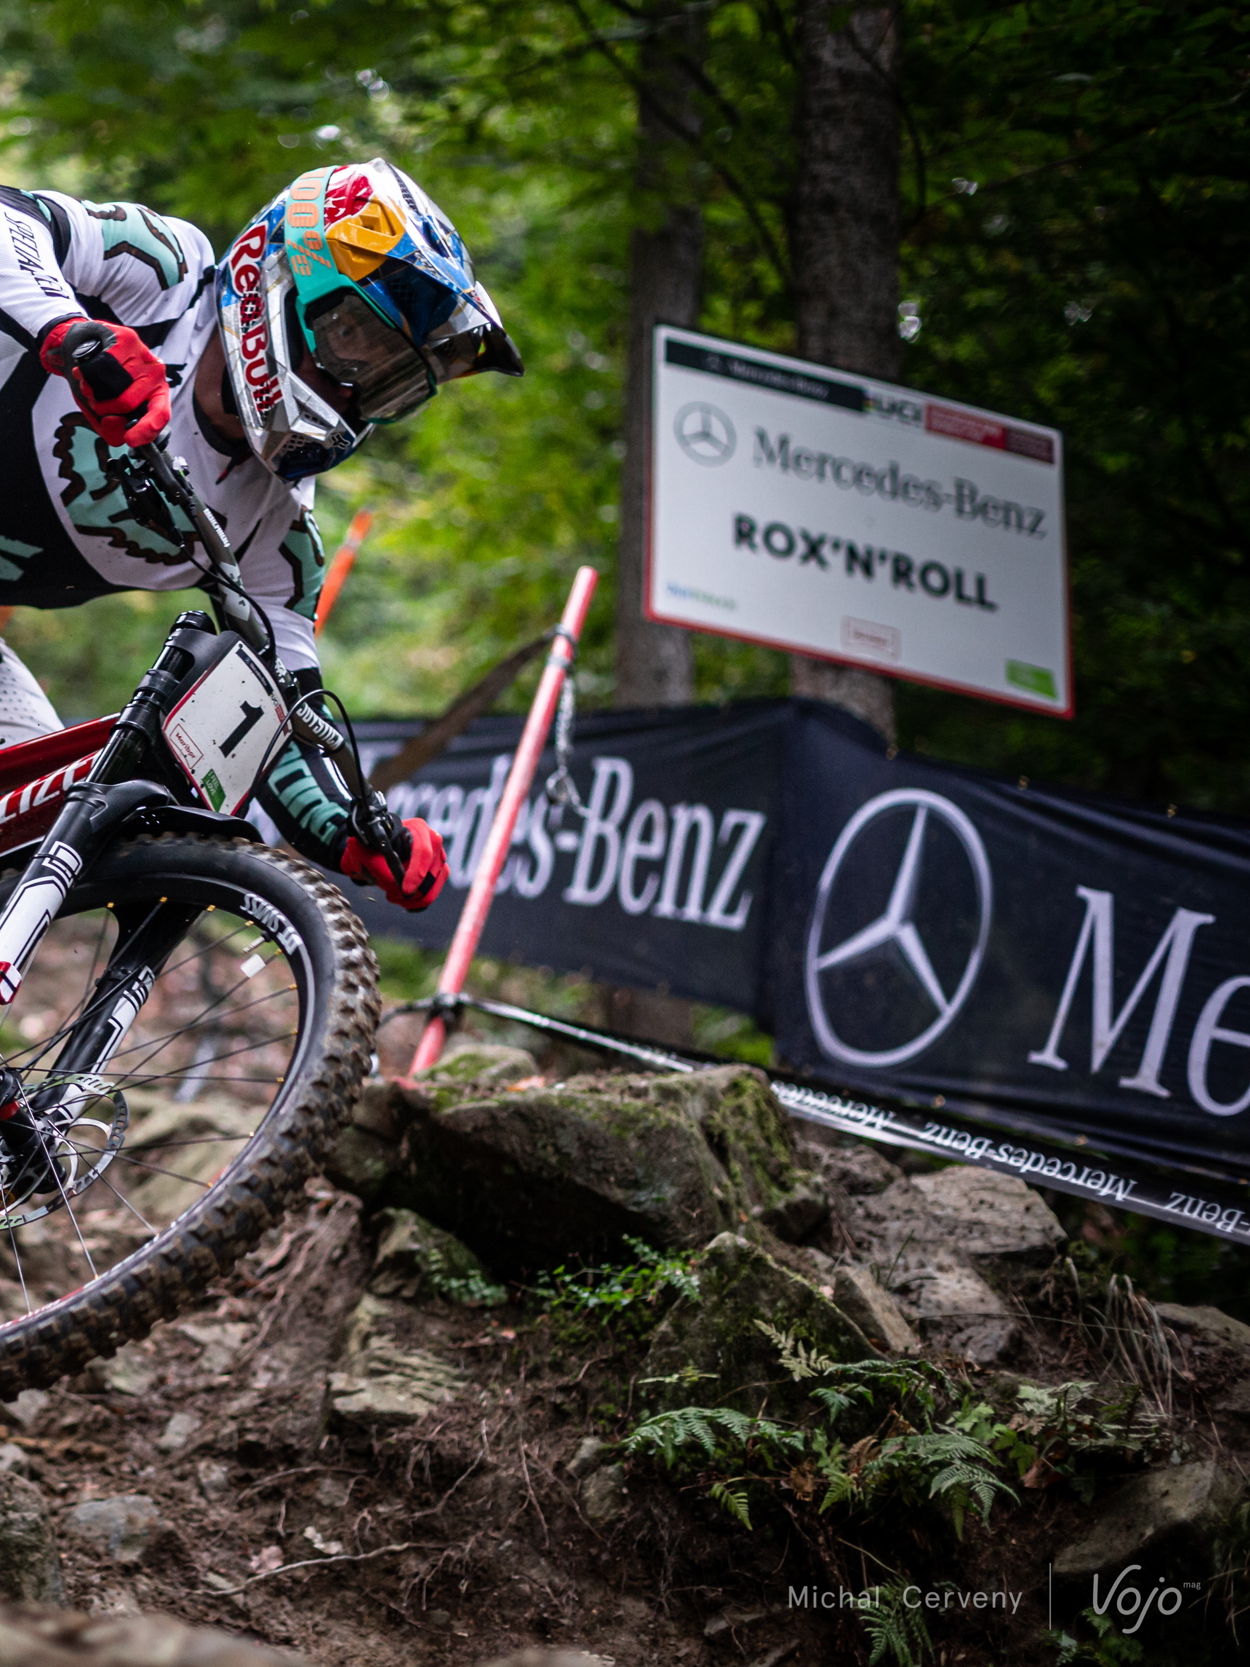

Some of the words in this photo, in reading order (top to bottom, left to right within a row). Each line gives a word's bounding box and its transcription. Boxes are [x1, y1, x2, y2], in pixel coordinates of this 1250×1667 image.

[4, 212, 70, 300] SPECIALED
[287, 167, 332, 276] 100%
[753, 424, 1048, 540] Mercedes-Benz
[733, 512, 999, 613] ROX'N'ROLL
[219, 700, 265, 758] 1
[240, 892, 286, 933] SWISS
[276, 925, 303, 956] DT
[917, 1121, 1139, 1202] Mercedes-Benz
